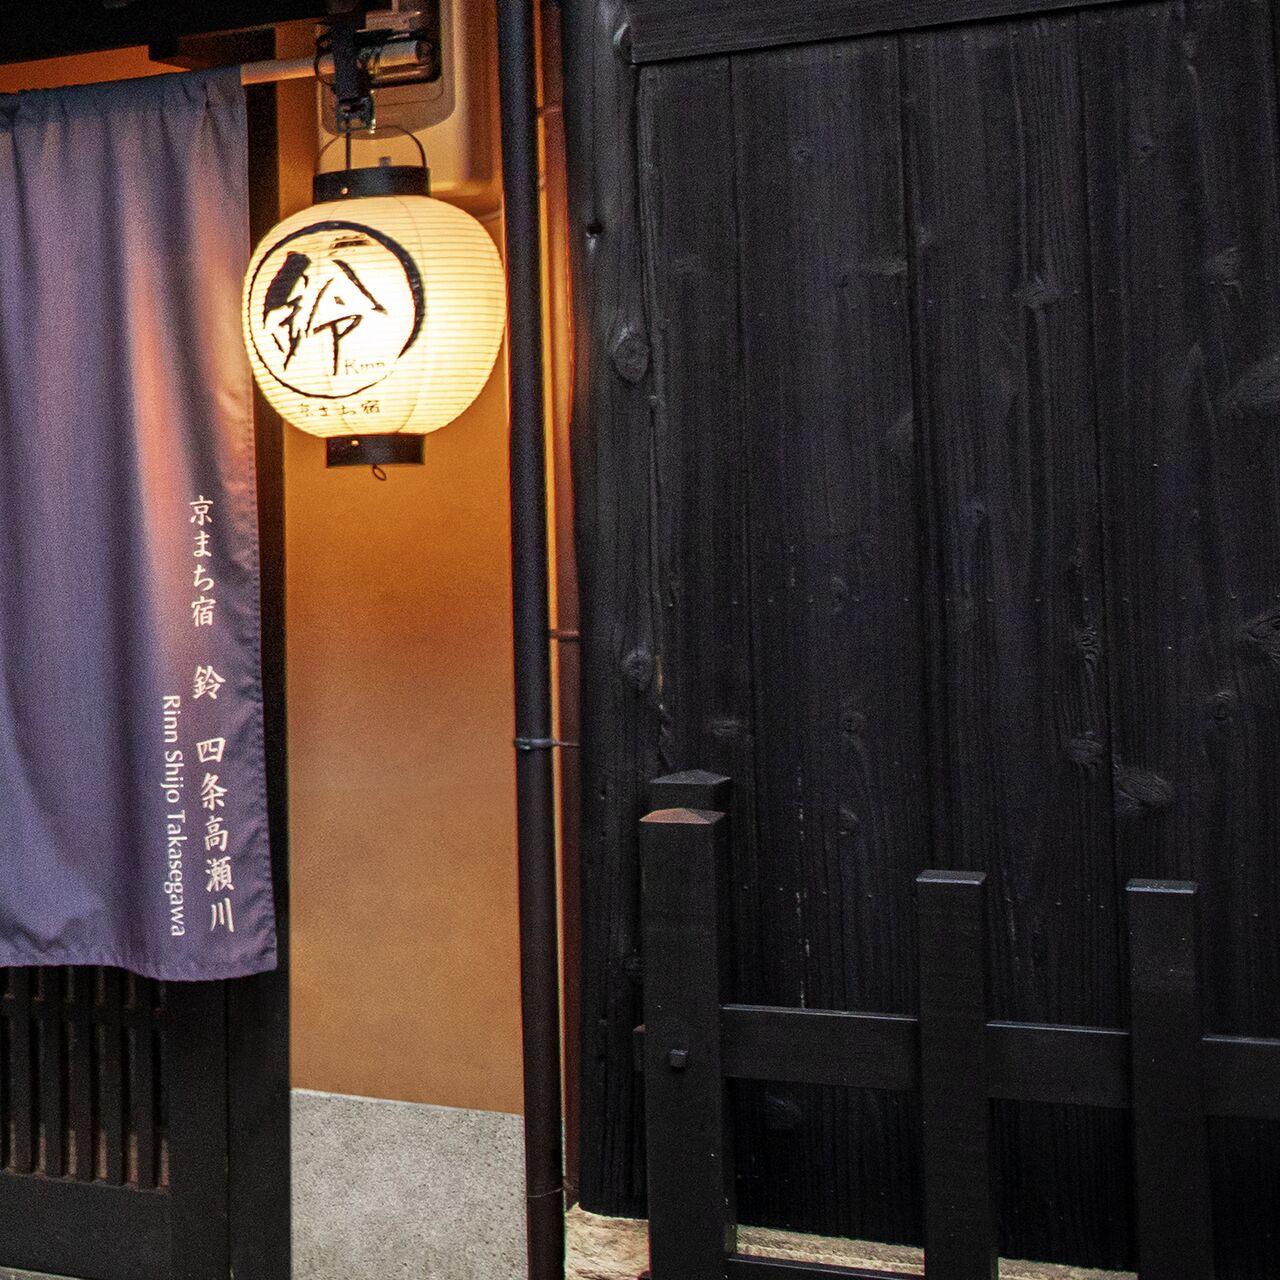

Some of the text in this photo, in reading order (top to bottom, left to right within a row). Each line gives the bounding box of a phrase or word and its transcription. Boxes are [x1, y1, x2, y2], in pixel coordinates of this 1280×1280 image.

[160, 695, 188, 937] Rinn Shijo Takasegawa
[190, 495, 235, 933] 京まち宿 鈴 四条高瀬川
